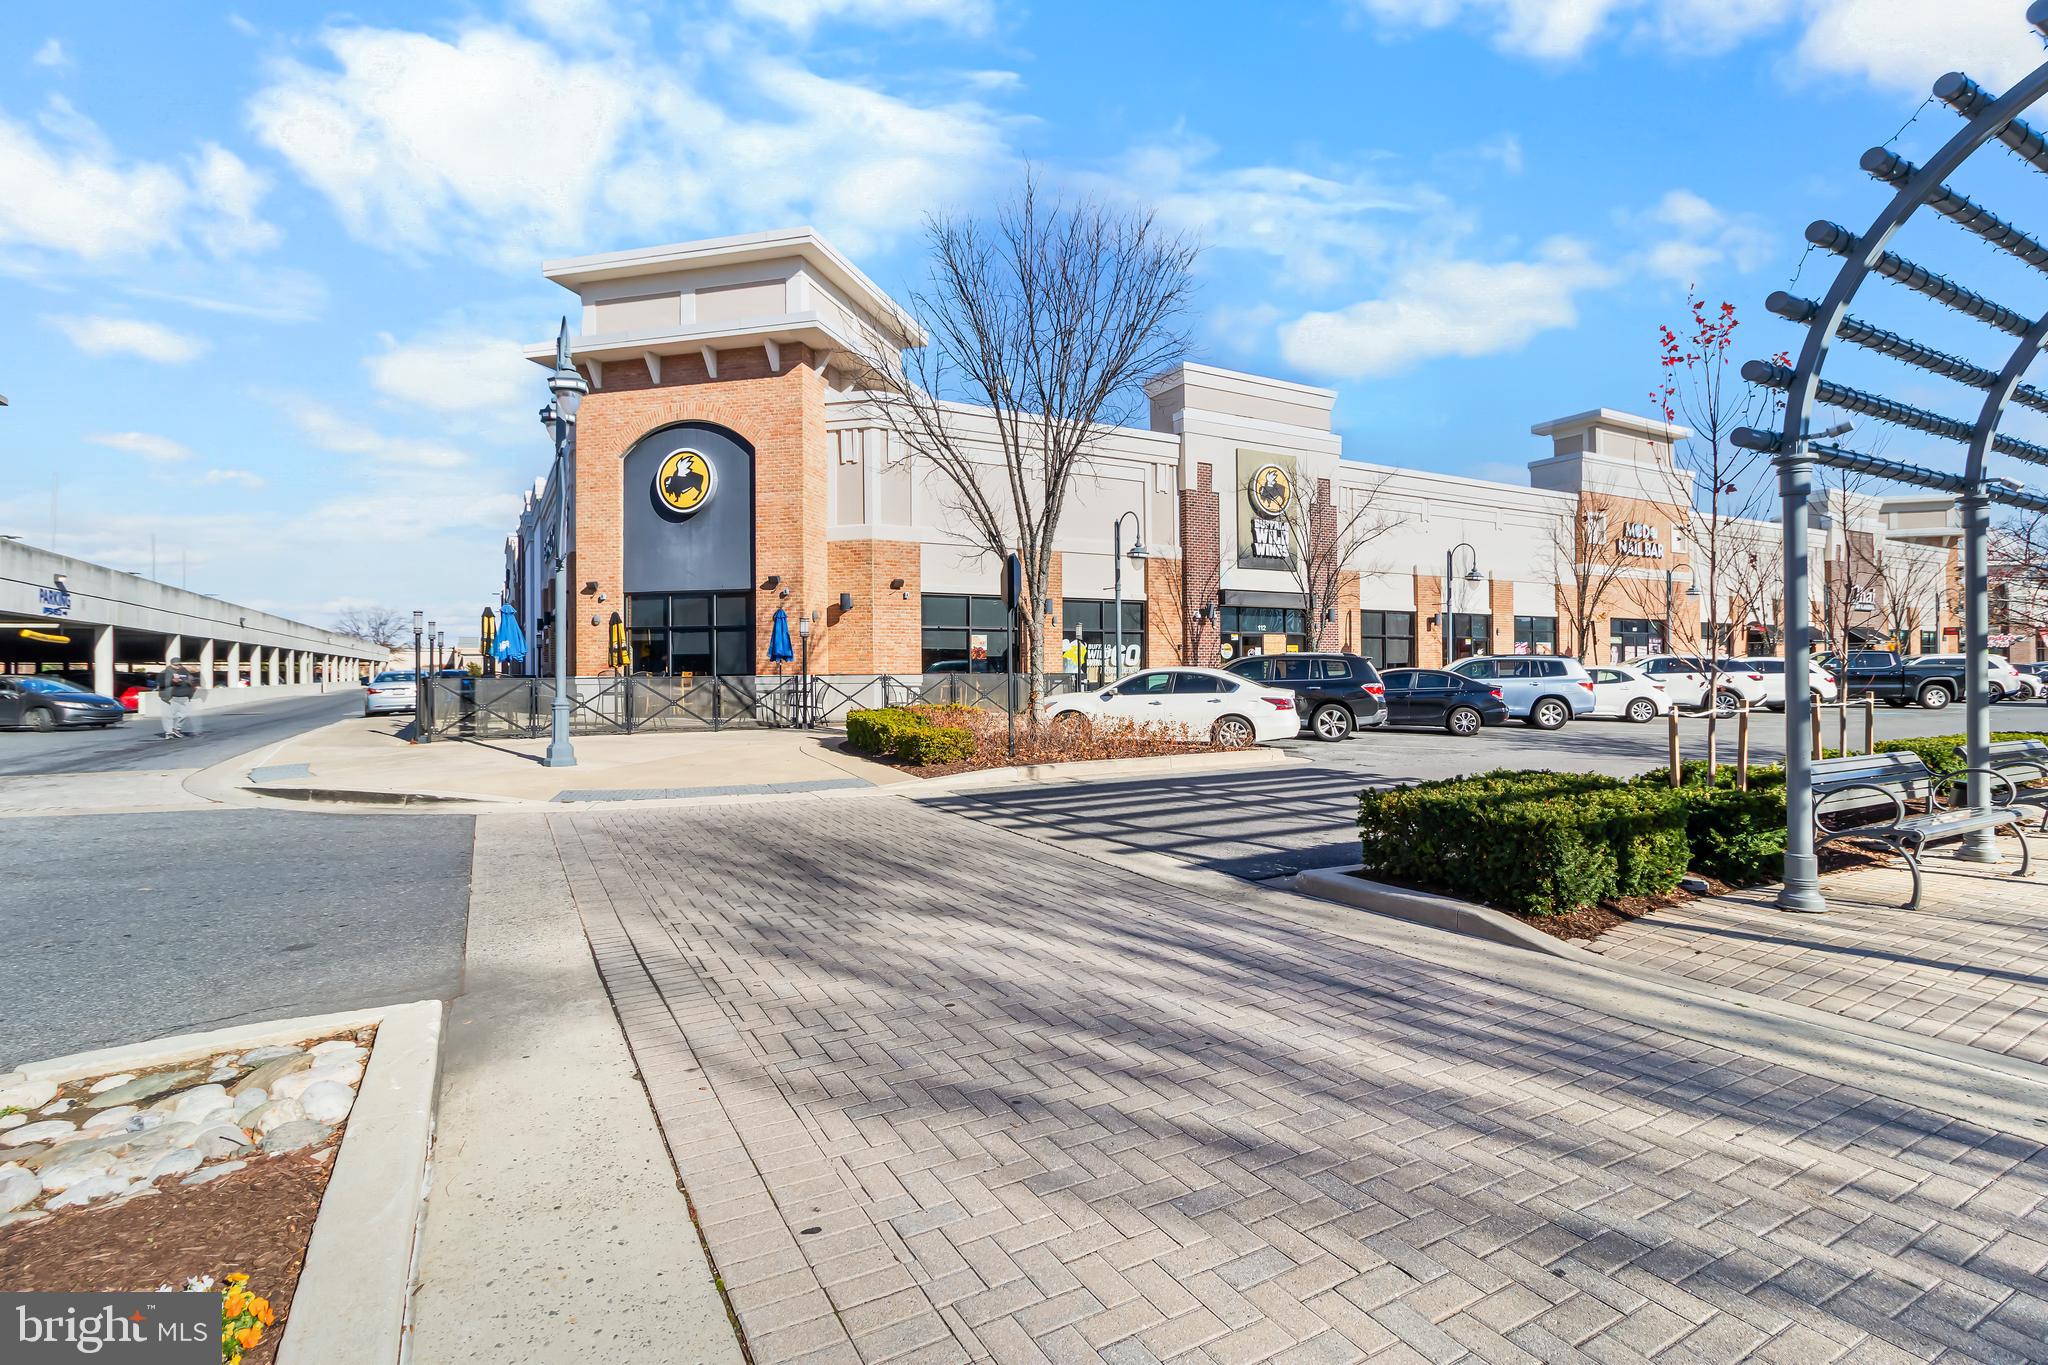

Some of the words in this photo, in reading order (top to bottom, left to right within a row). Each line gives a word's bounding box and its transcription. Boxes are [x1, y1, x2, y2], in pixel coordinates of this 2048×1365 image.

[1254, 528, 1289, 546] WILD
[1253, 543, 1290, 558] WINGS
[1617, 538, 1644, 557] NAIL
[1644, 541, 1664, 559] BAR
[40, 588, 71, 607] PARKING
